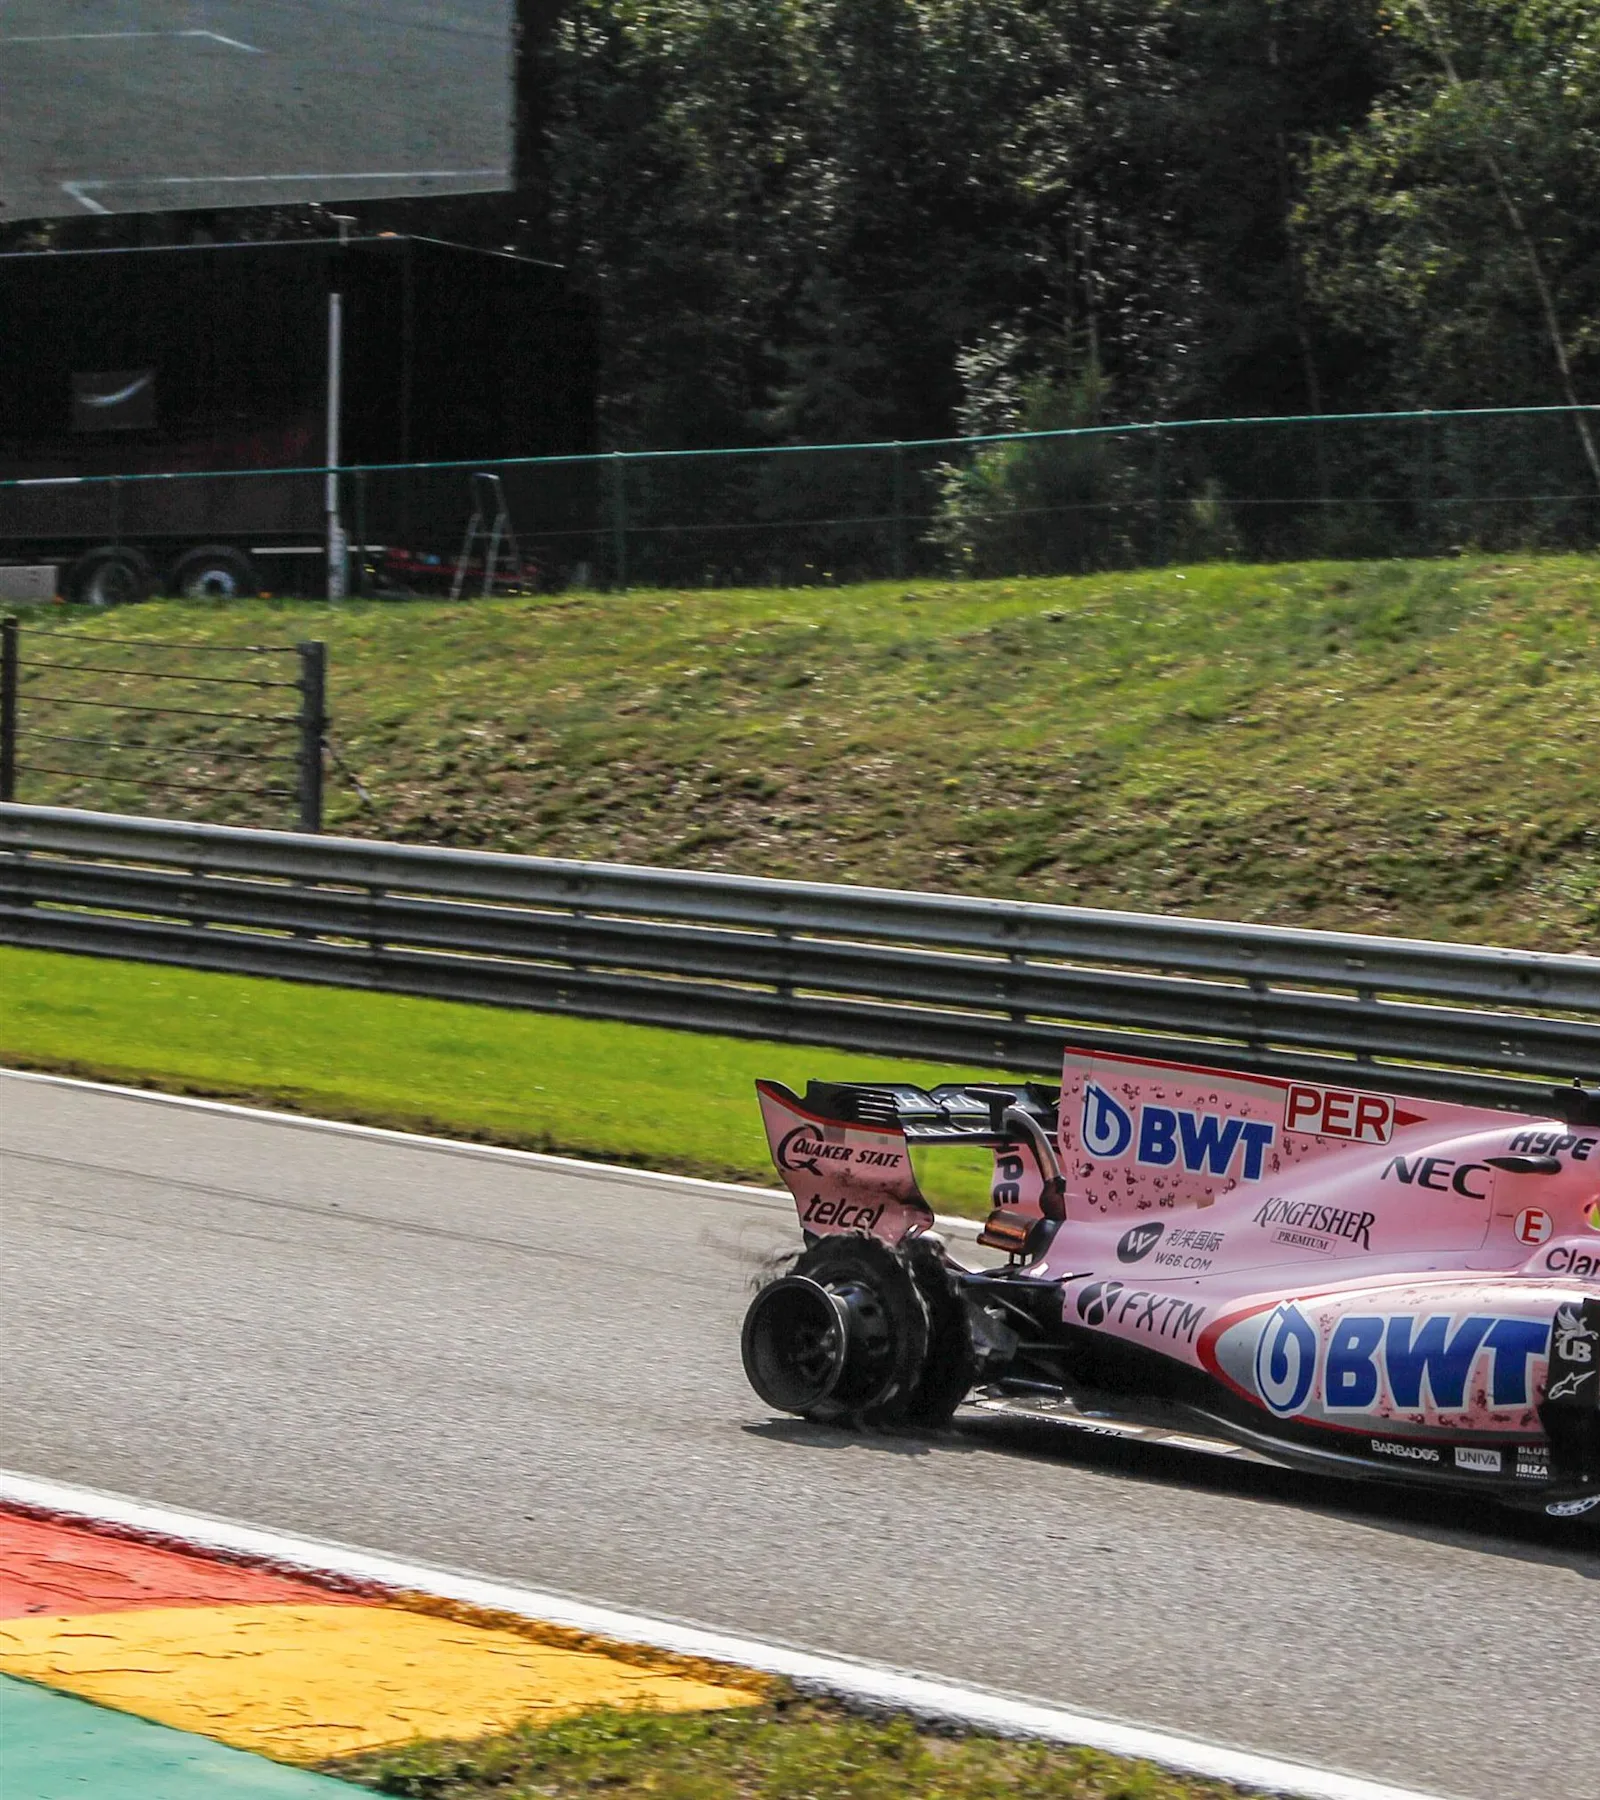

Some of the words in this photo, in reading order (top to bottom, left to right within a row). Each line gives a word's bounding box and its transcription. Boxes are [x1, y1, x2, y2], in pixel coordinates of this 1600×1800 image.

[1287, 1088, 1391, 1142] PER
[791, 1136, 854, 1161] QUAKER
[855, 1149, 903, 1169] STATE
[1138, 1105, 1274, 1181] BWT
[1508, 1132, 1598, 1161] HYPE
[1380, 1156, 1491, 1200] NEC
[803, 1193, 885, 1230] telcel
[1251, 1197, 1377, 1251] KINGFISHER
[1521, 1210, 1544, 1243] E
[1276, 1230, 1330, 1251] PREMIUM
[1154, 1252, 1213, 1270] W66.COM
[1117, 1291, 1207, 1344] FXTM
[1326, 1316, 1551, 1409] BWT
[1371, 1439, 1440, 1463] BARBADOS
[1457, 1450, 1499, 1468] UNIVA
[1517, 1446, 1549, 1456] BLUE
[1516, 1464, 1548, 1475] IBIZA
